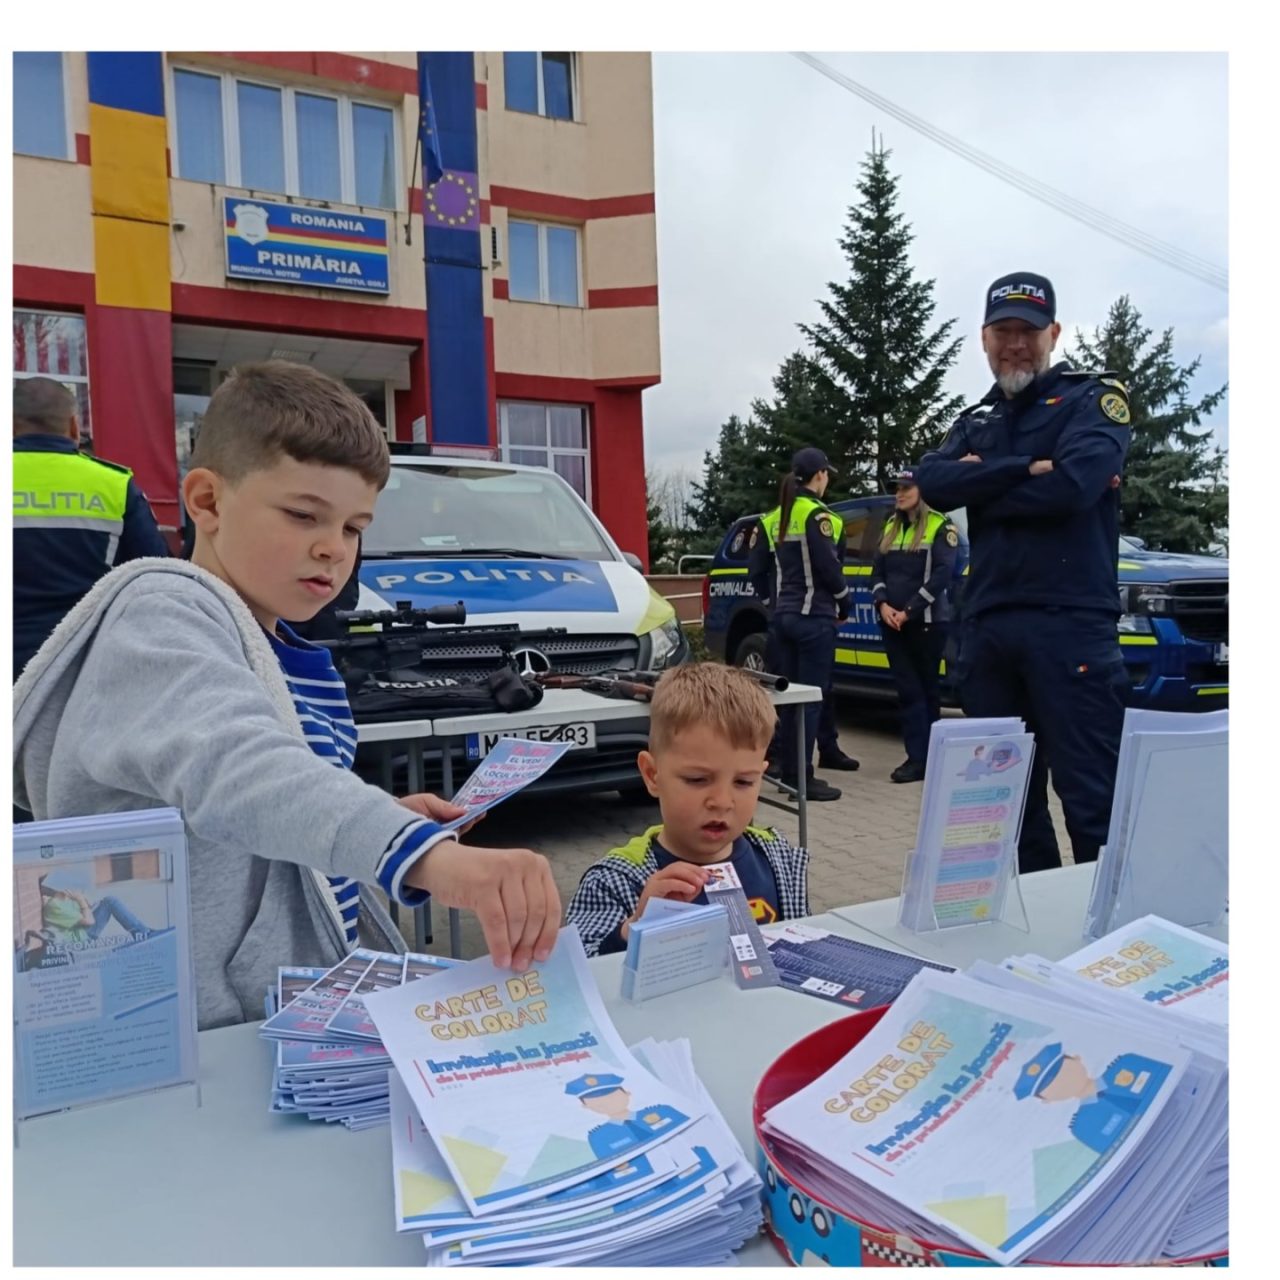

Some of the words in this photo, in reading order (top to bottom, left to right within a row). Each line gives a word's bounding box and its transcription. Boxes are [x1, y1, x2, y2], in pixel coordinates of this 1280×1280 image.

[291, 213, 365, 233] ROMANIA
[257, 250, 362, 275] PRIMĂRIA
[991, 283, 1046, 301] POLITIA
[376, 568, 595, 589] POLITIA
[378, 678, 459, 689] POLITIA
[415, 985, 503, 1022] CARTE
[505, 970, 545, 1003] DE
[431, 1000, 548, 1040] COLORAT
[824, 1054, 906, 1114] CARTE
[896, 1020, 937, 1054] DE
[850, 1032, 954, 1123] COLORAT
